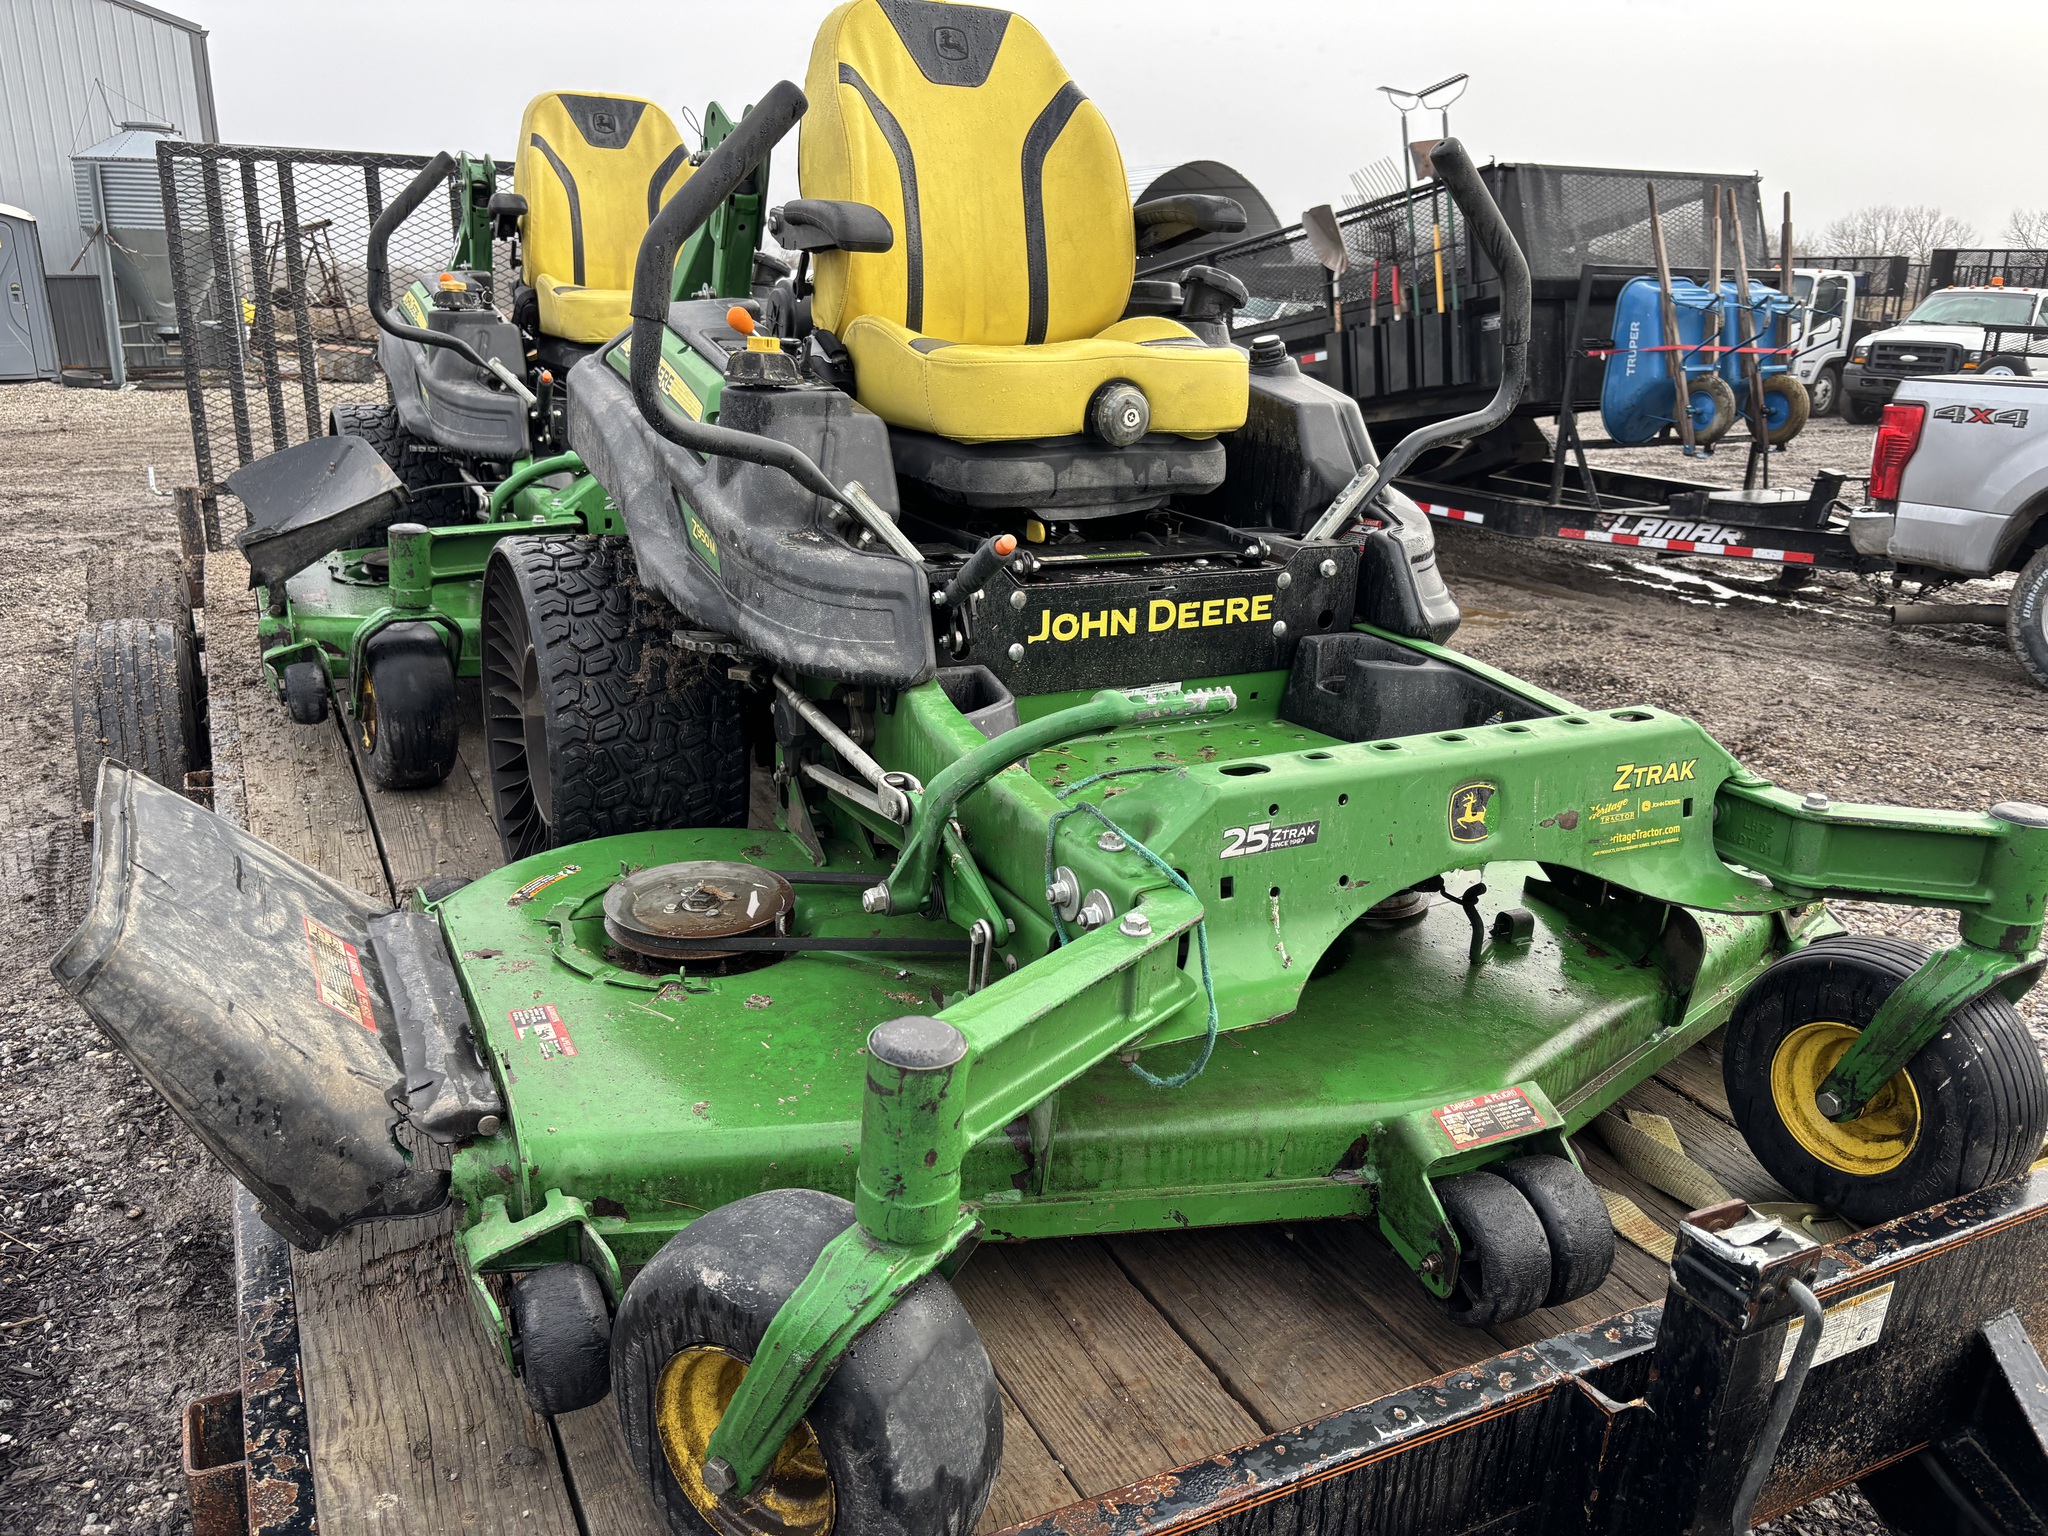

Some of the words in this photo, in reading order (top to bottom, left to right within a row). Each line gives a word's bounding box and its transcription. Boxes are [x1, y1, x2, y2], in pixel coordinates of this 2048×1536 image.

[1626, 321, 1640, 377] TRUPER
[691, 517, 717, 558] Z950M
[1608, 515, 1742, 546] LAMAR
[1027, 607, 1137, 644] JOHN
[1148, 594, 1274, 633] DEERE
[1612, 758, 1699, 792] ZTRAK
[1271, 824, 1316, 842] ZTRAK
[1600, 811, 1635, 824] TRACTOR
[1220, 822, 1272, 859] 25
[1270, 841, 1289, 849] SINCE
[1289, 838, 1306, 846] 1997
[1449, 1099, 1477, 1112] DANGER
[1490, 1089, 1518, 1102] PELIGRO
